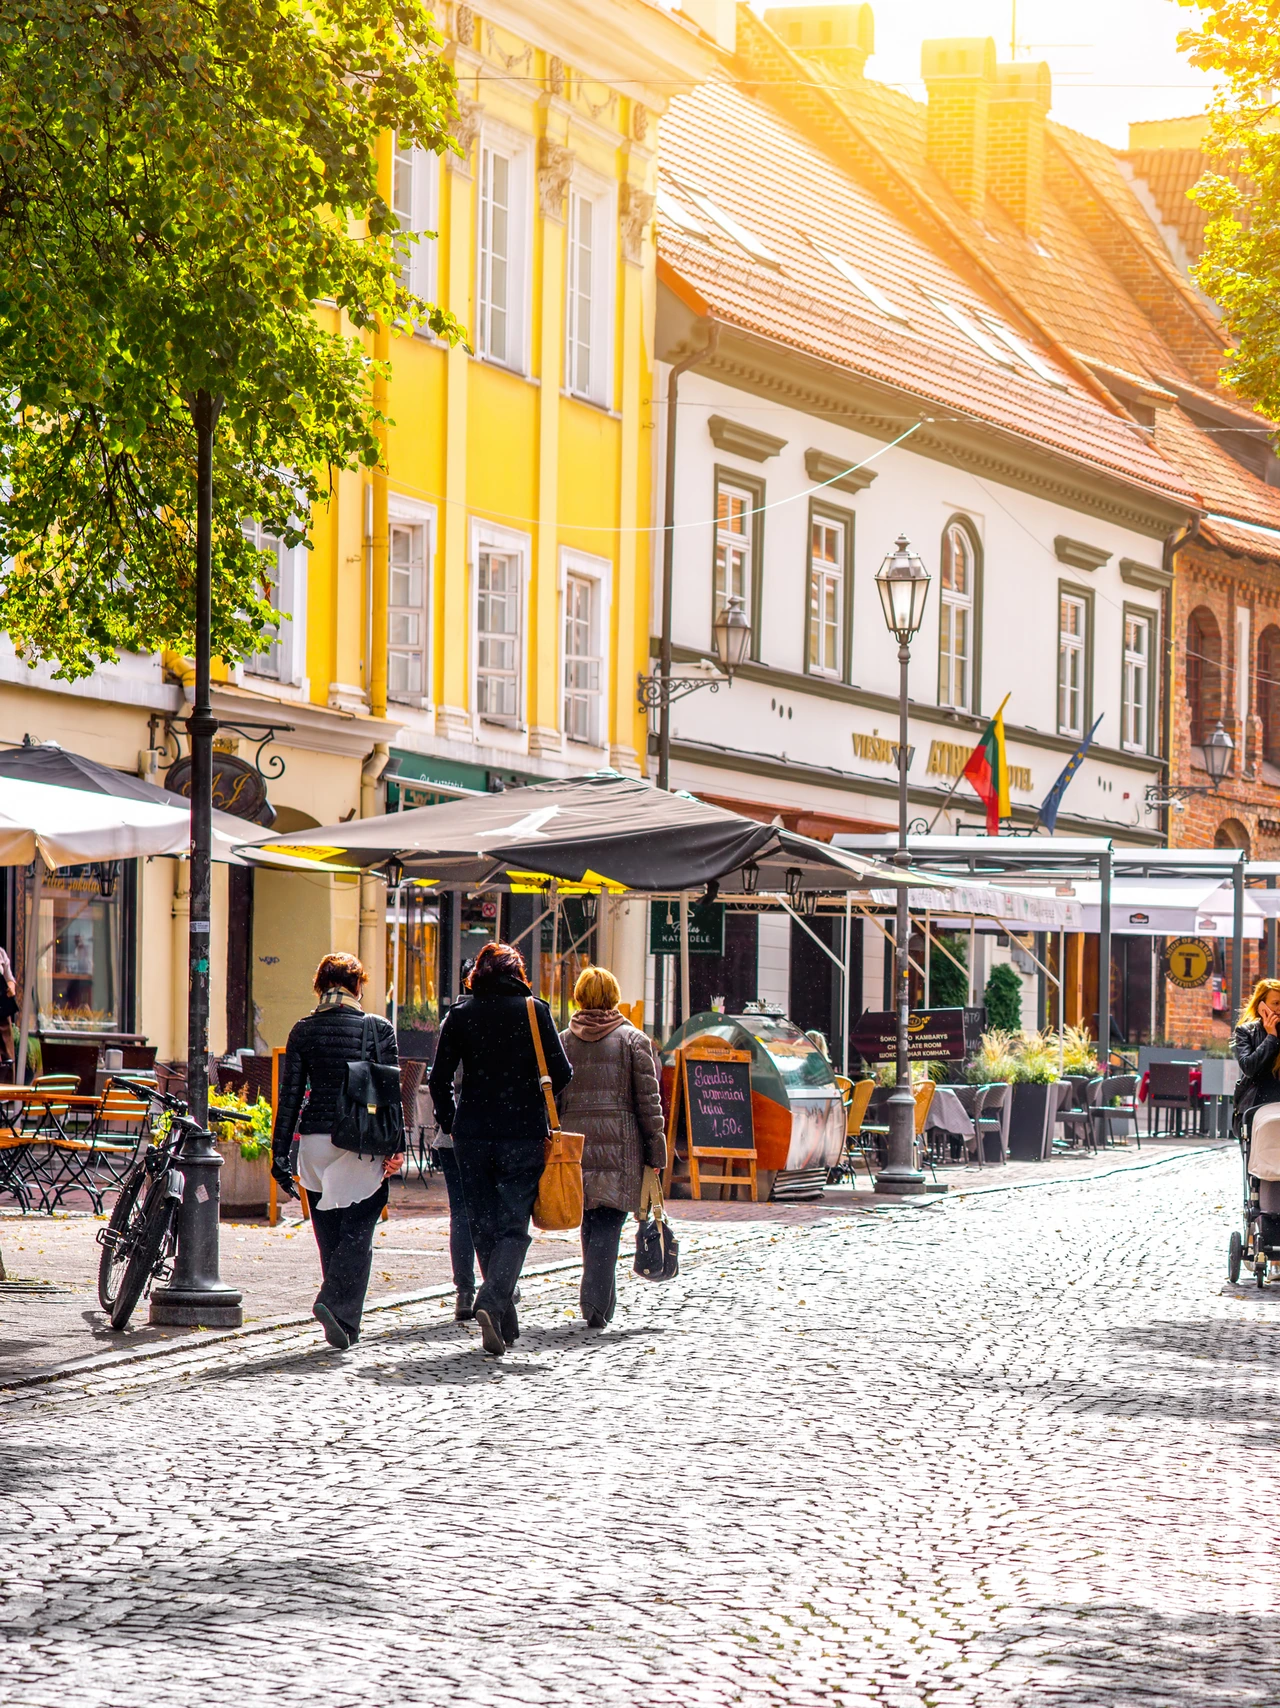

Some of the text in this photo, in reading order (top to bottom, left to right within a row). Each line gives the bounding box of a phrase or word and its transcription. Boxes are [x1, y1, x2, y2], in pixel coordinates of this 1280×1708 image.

[852, 729, 912, 764] VIEŠBU
[1006, 764, 1034, 791] OTEL
[915, 1033, 948, 1041] KAMBARYS
[698, 1099, 725, 1115] ledai
